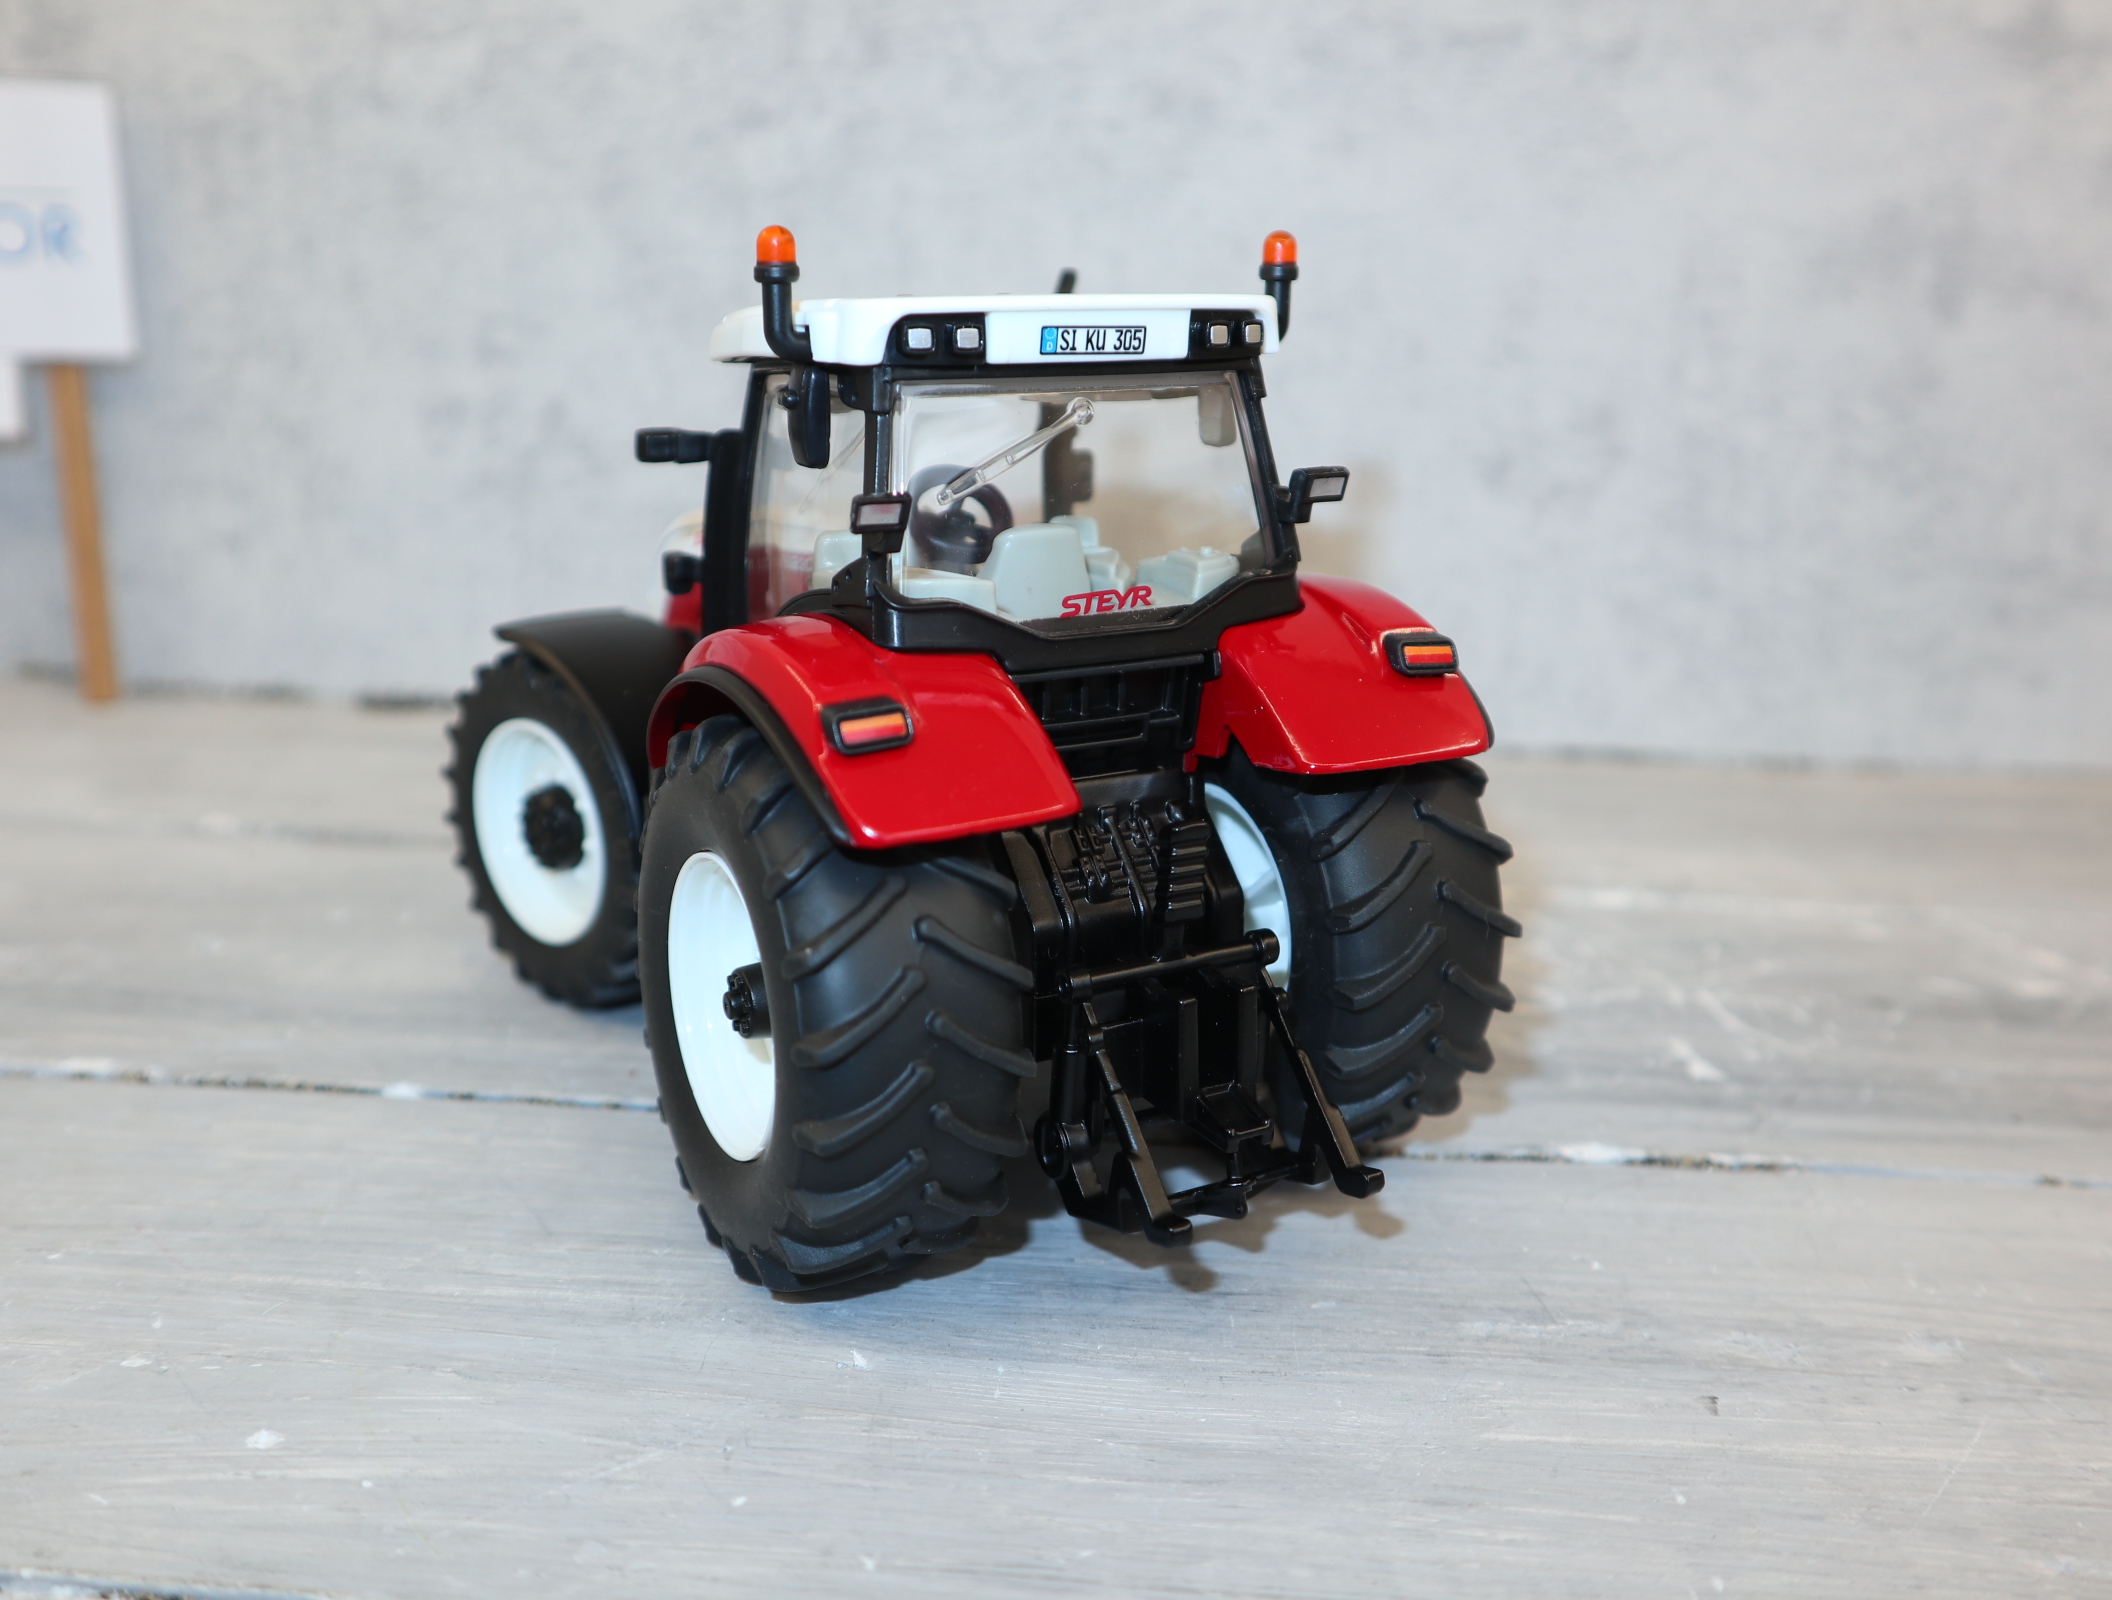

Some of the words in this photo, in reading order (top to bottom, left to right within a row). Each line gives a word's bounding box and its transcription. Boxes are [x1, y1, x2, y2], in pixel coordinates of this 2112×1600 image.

[1059, 329, 1077, 351] SI
[1085, 329, 1106, 351] KU
[1113, 329, 1143, 351] 305
[1060, 585, 1152, 619] STEYR
